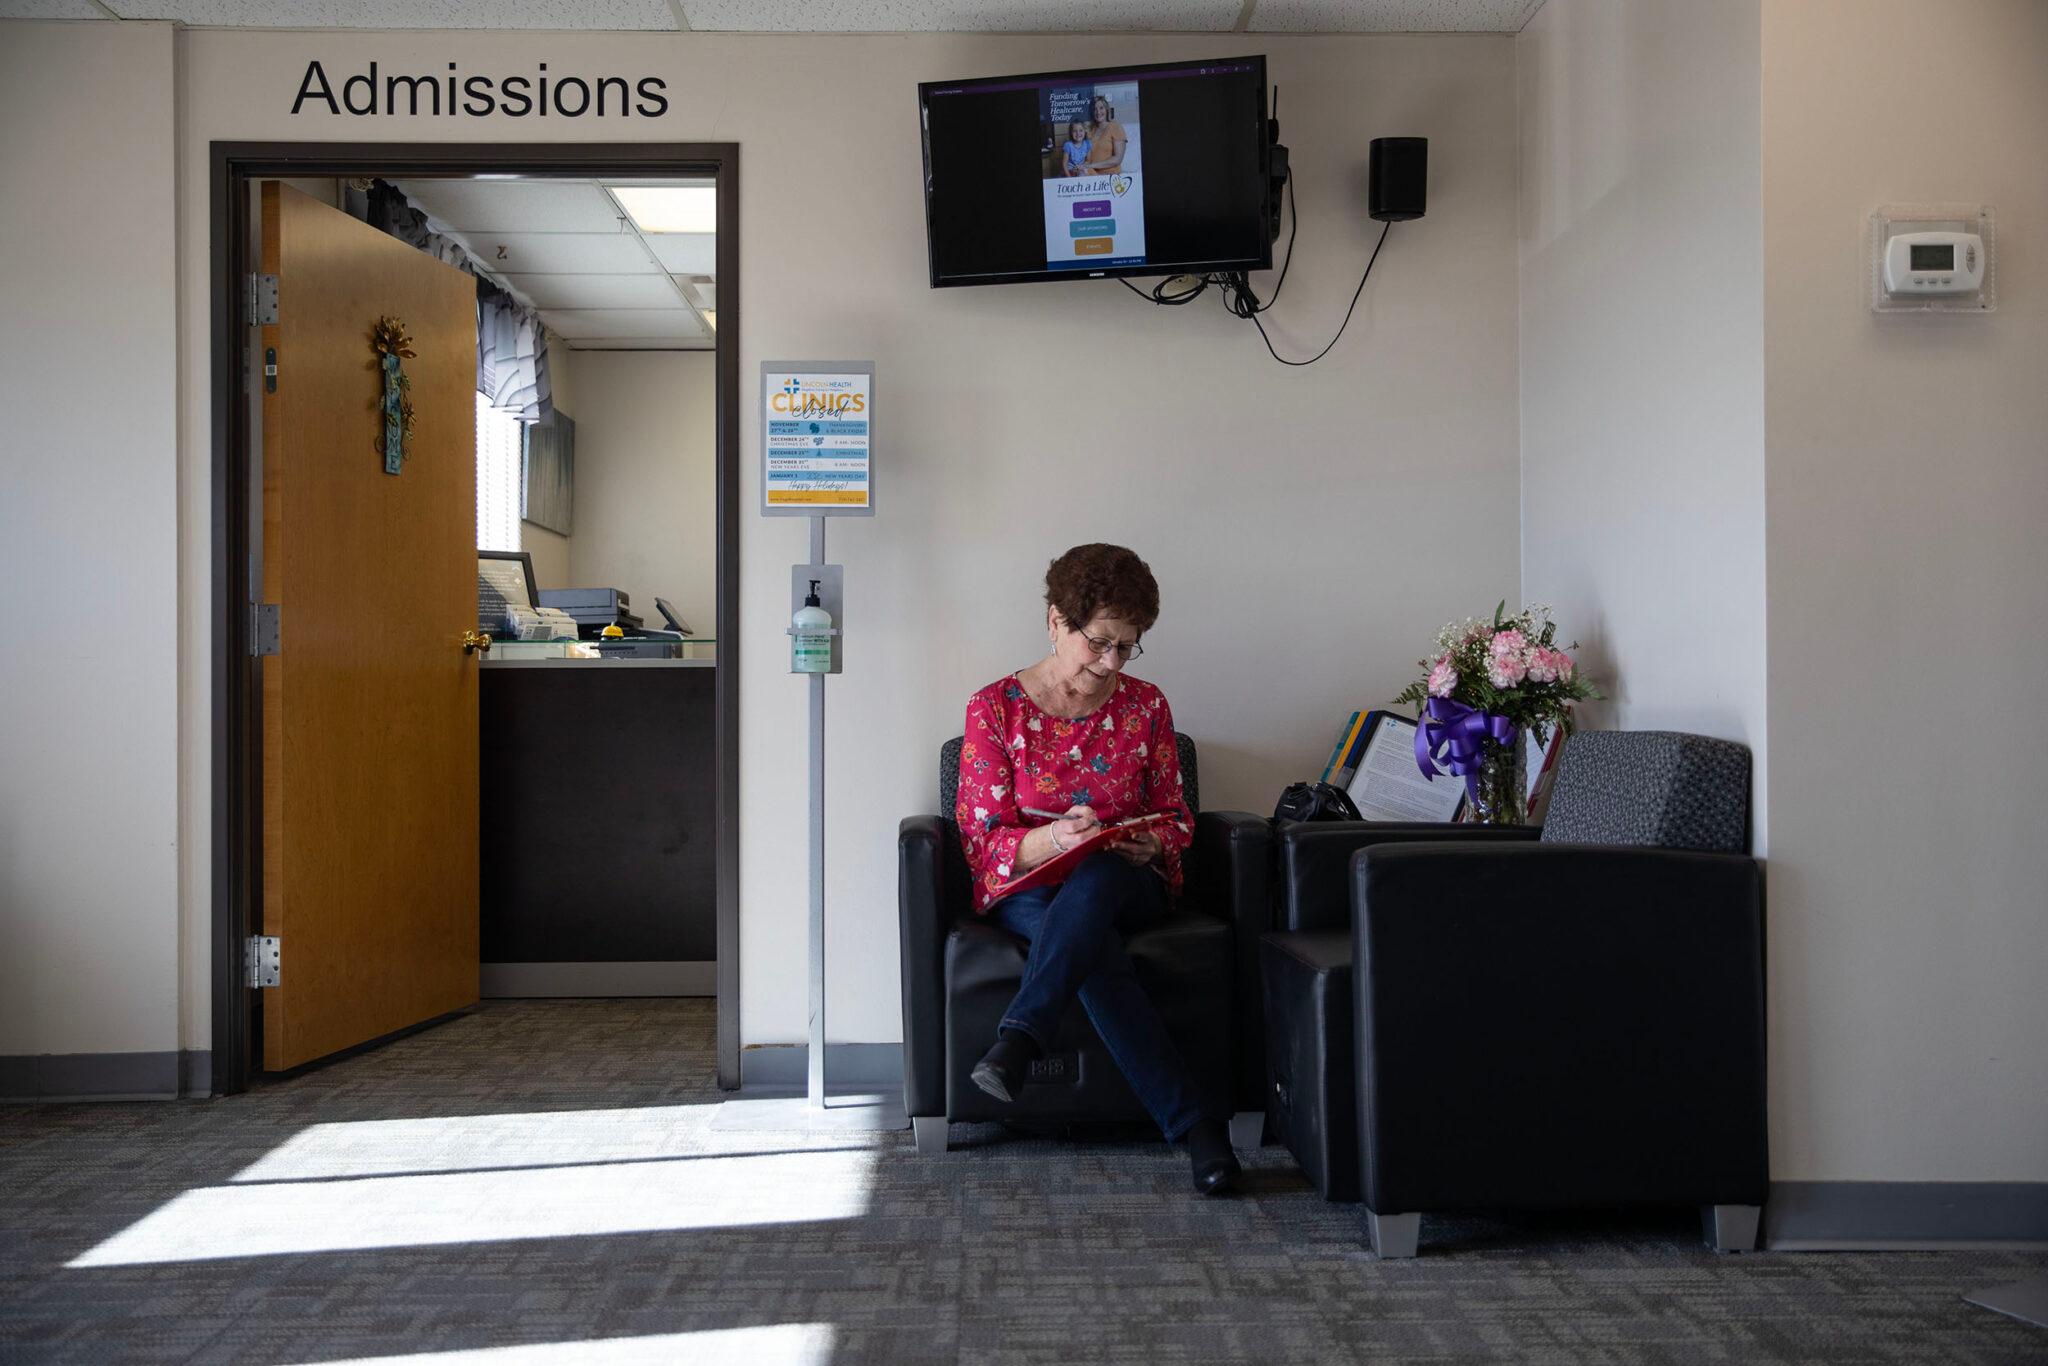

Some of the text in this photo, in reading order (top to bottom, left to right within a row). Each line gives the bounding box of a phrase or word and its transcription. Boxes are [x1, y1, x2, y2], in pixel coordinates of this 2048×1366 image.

[290, 60, 669, 118] Admissions
[1049, 92, 1079, 101] Funding
[1049, 97, 1091, 107] Tomorrow's
[1051, 114, 1073, 122] Today
[1056, 180, 1110, 194] Touch a Life
[771, 393, 865, 413] CLINICS
[791, 399, 849, 421] closed
[787, 480, 849, 492] Happy Holidays!
